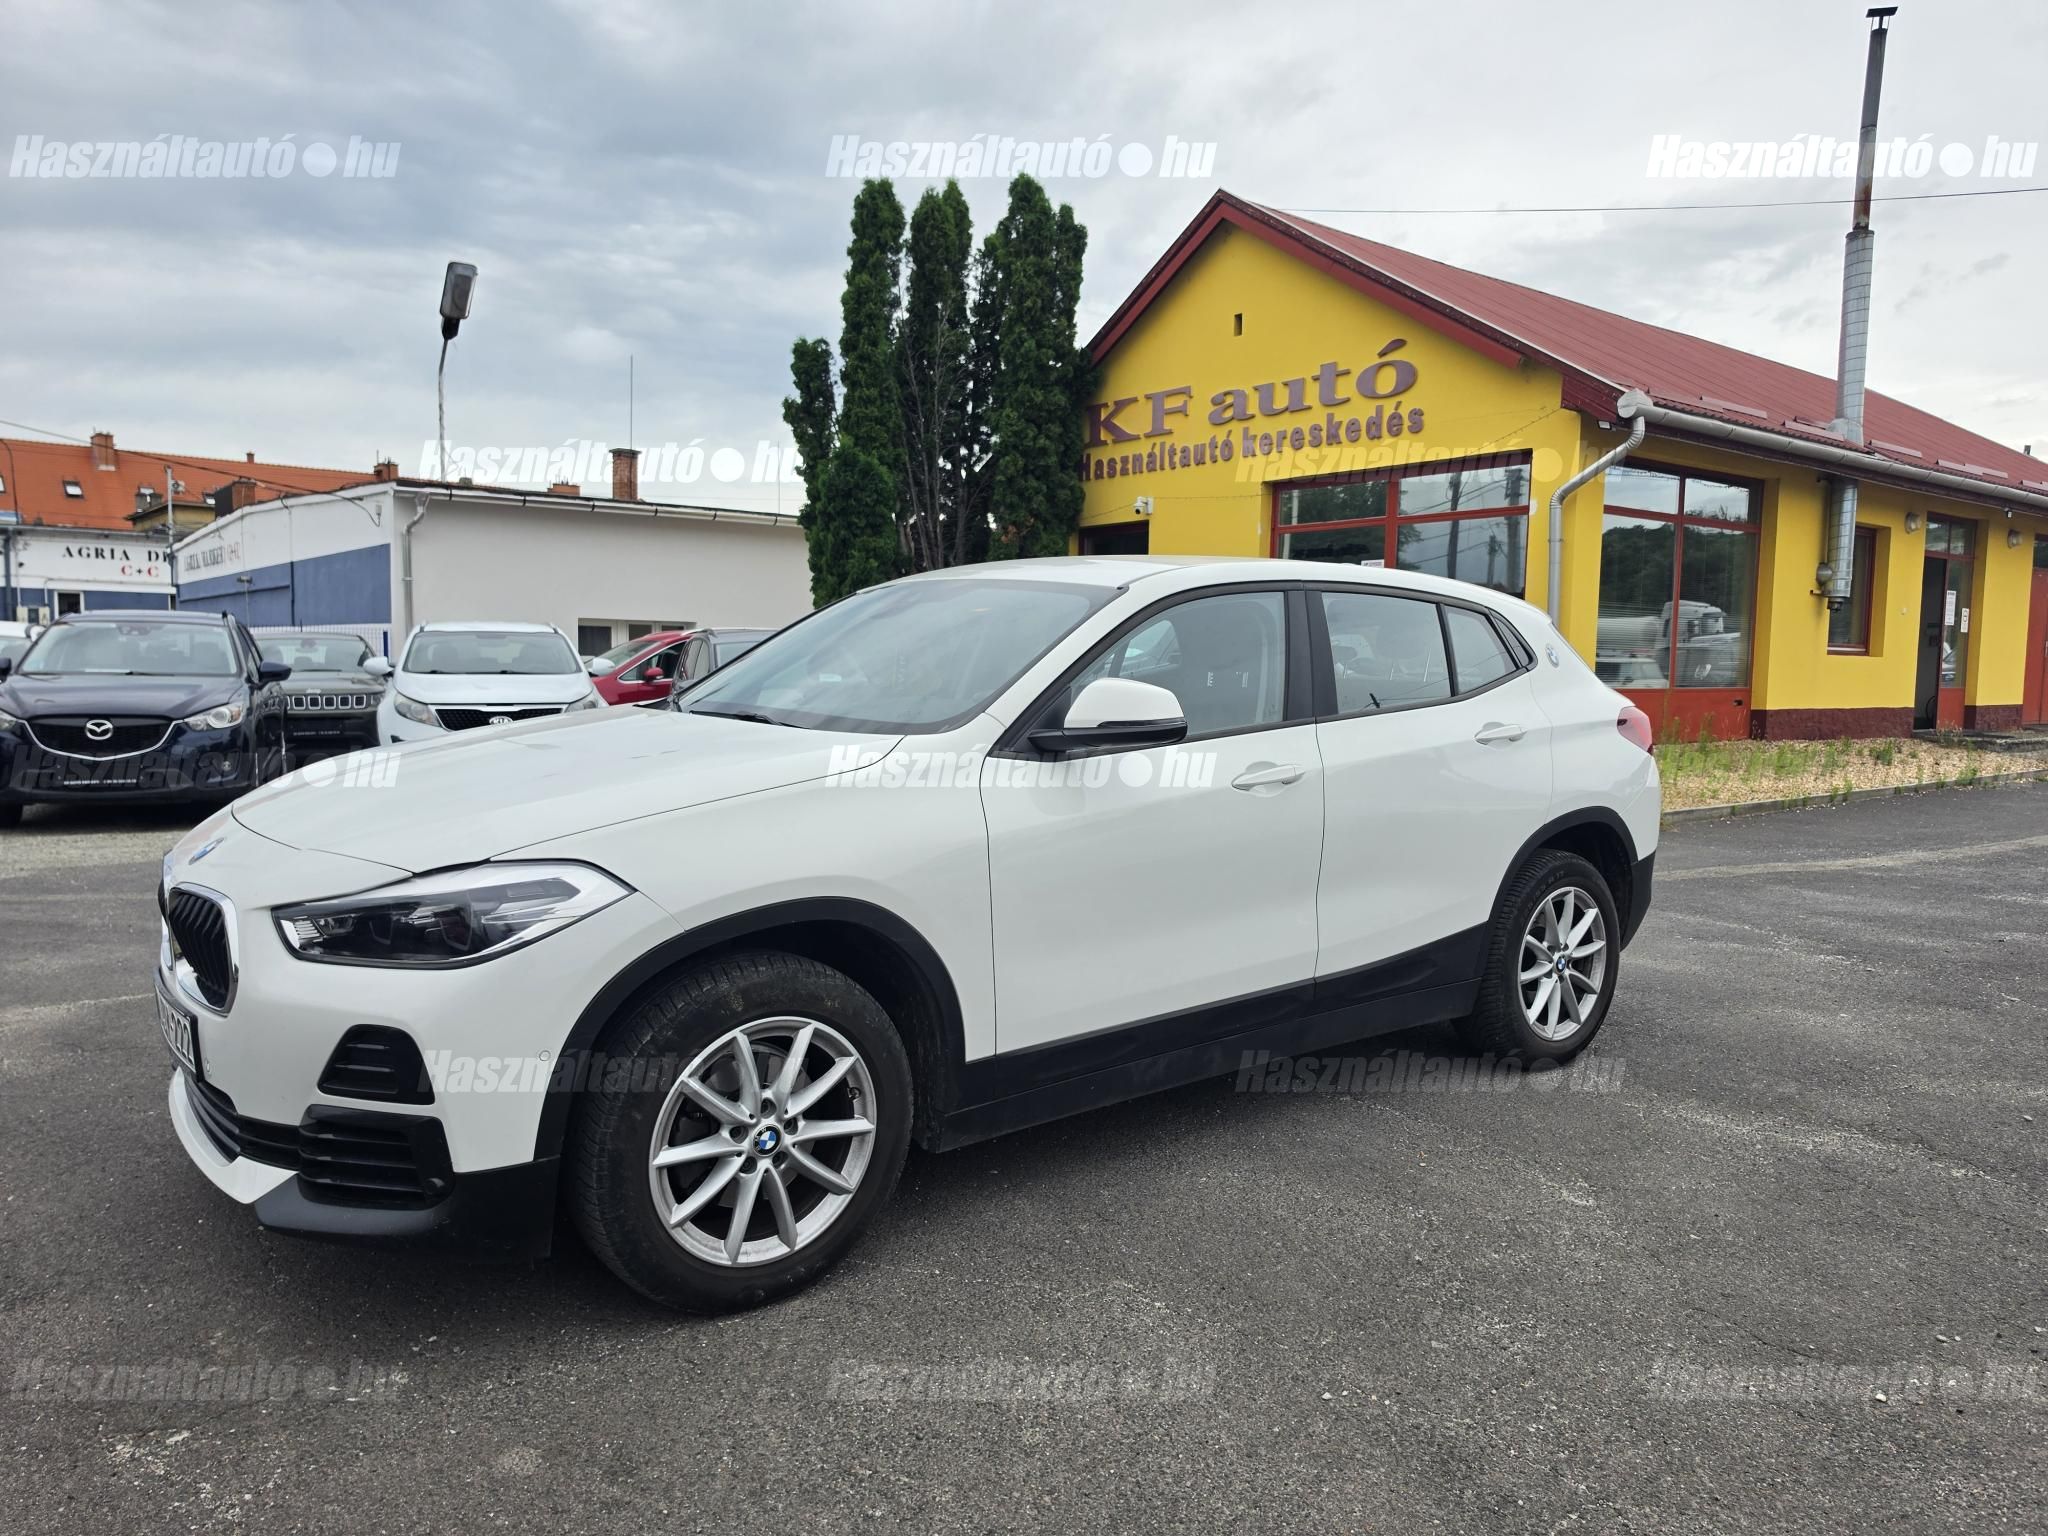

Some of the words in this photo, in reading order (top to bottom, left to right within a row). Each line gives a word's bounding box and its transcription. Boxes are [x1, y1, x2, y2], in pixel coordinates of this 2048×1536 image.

[1084, 385, 1193, 448] KF
[1208, 338, 1418, 426] autó
[1079, 430, 1234, 482] Használtautó
[1242, 401, 1425, 458] kereskedés
[63, 546, 130, 561] AGRIA
